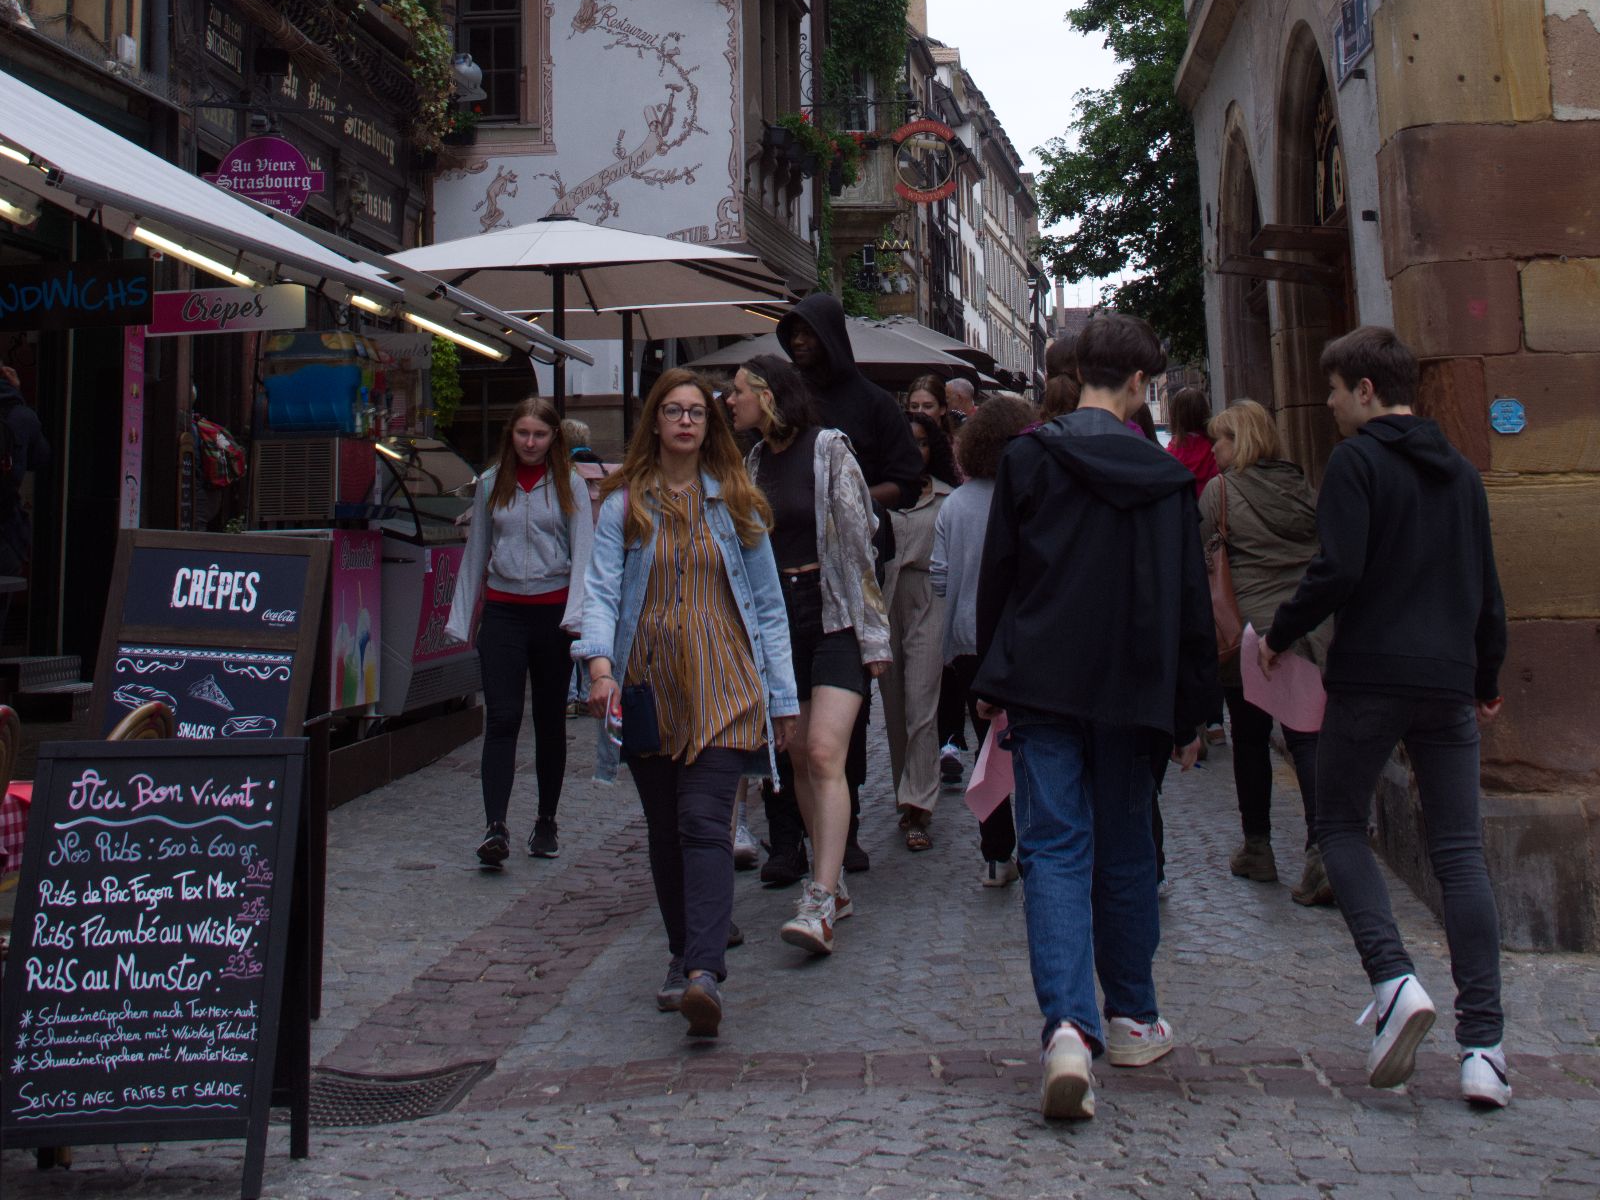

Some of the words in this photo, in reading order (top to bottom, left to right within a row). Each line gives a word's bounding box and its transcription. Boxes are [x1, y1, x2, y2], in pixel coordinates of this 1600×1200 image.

[595, 4, 659, 45] Restaurant
[216, 174, 313, 191] Strasbourg
[231, 159, 251, 173] Au
[256, 158, 297, 172] Vieux
[599, 148, 653, 187] Bouchon
[181, 294, 267, 328] Crêpes
[171, 564, 260, 613] CRÊPES
[177, 722, 215, 739] SNACKS
[69, 769, 126, 809] Au
[129, 773, 183, 812] Bon
[49, 832, 90, 866] Nos
[158, 837, 186, 859] 500
[190, 836, 203, 854] à
[208, 834, 235, 857] 600
[40, 880, 77, 907] Ribs
[83, 880, 102, 904] de
[102, 876, 130, 904] Porc
[128, 874, 173, 911] Façon
[173, 870, 202, 900] Tex
[32, 912, 76, 949] Ribs
[81, 913, 161, 947] Flambé
[160, 924, 182, 945] au
[26, 956, 78, 992] Ribs
[82, 969, 110, 990] au
[154, 1001, 183, 1018] nach
[145, 1024, 168, 1039] mit
[148, 1044, 170, 1061] mit
[82, 1091, 114, 1106] AVEC
[172, 1085, 188, 1097] ET
